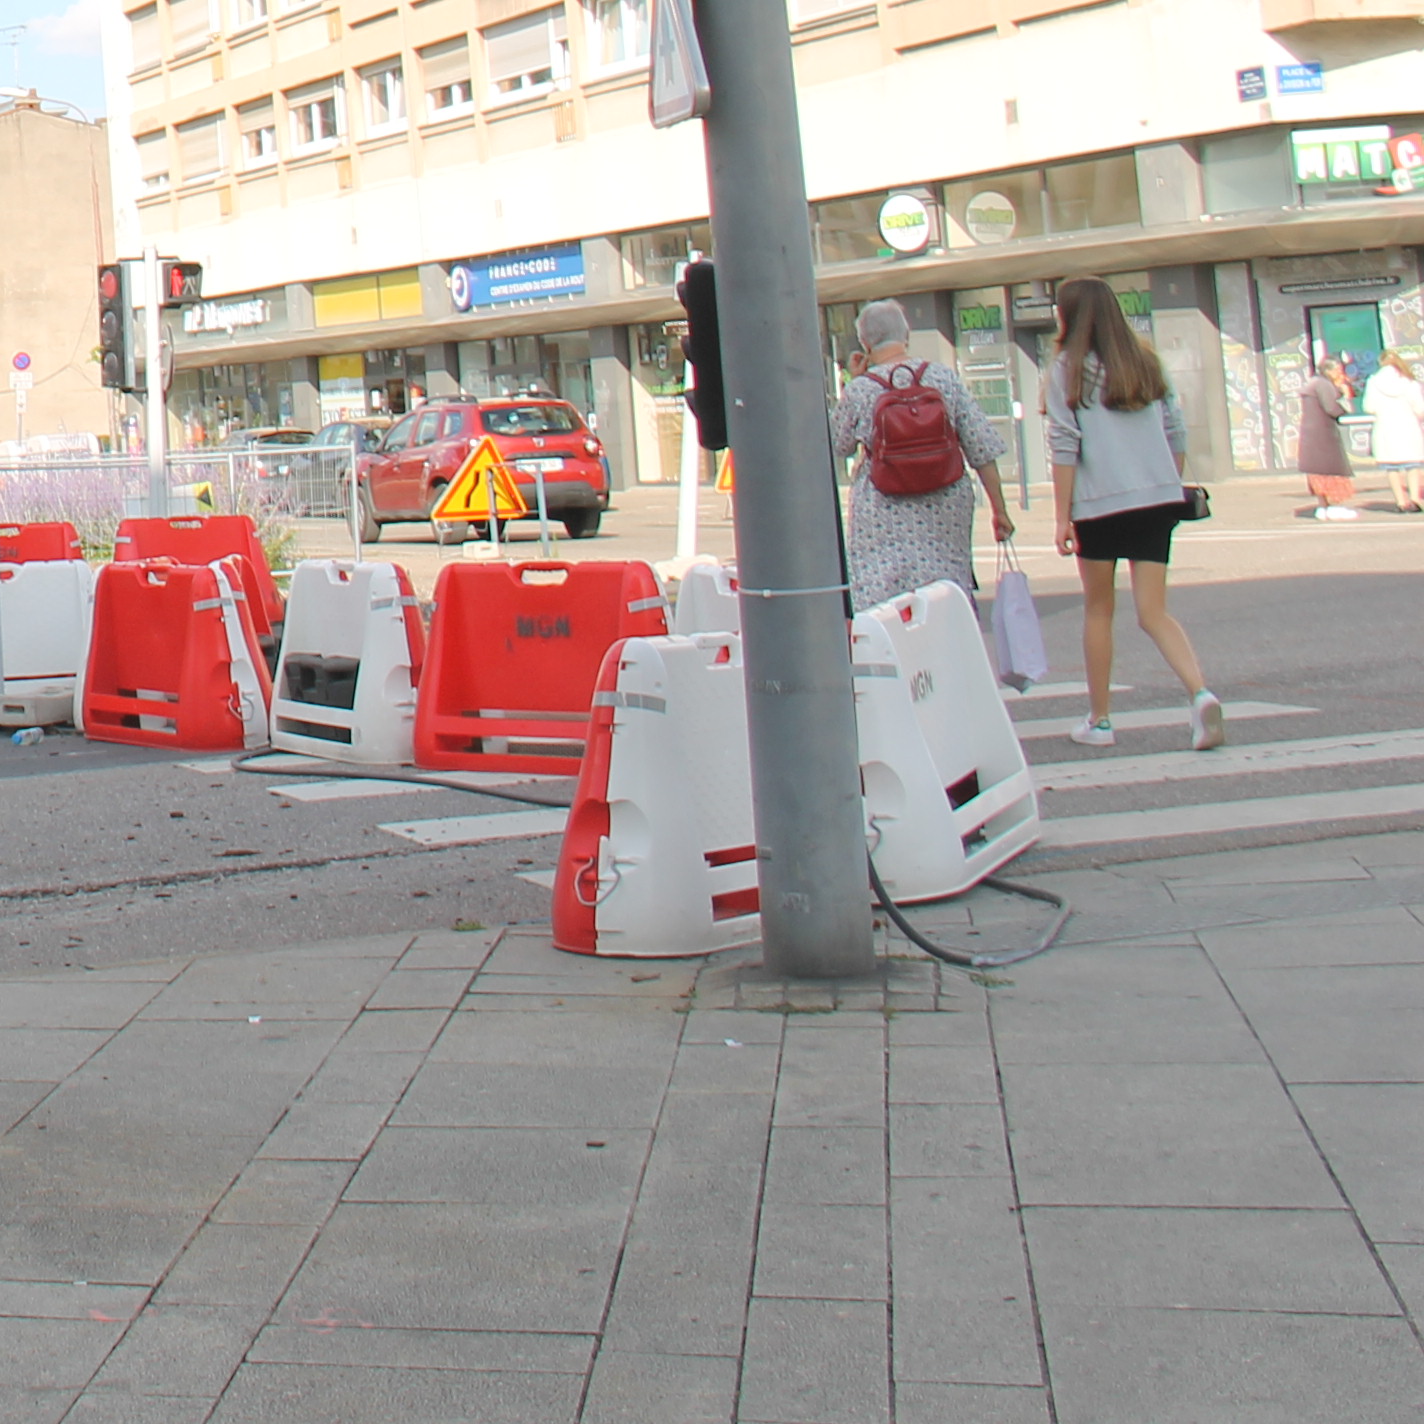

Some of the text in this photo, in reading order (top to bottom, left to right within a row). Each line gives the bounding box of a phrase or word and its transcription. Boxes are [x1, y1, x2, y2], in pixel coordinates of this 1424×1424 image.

[1297, 140, 1424, 180] MATC
[516, 615, 571, 639] MGN
[910, 670, 934, 703] MGN
